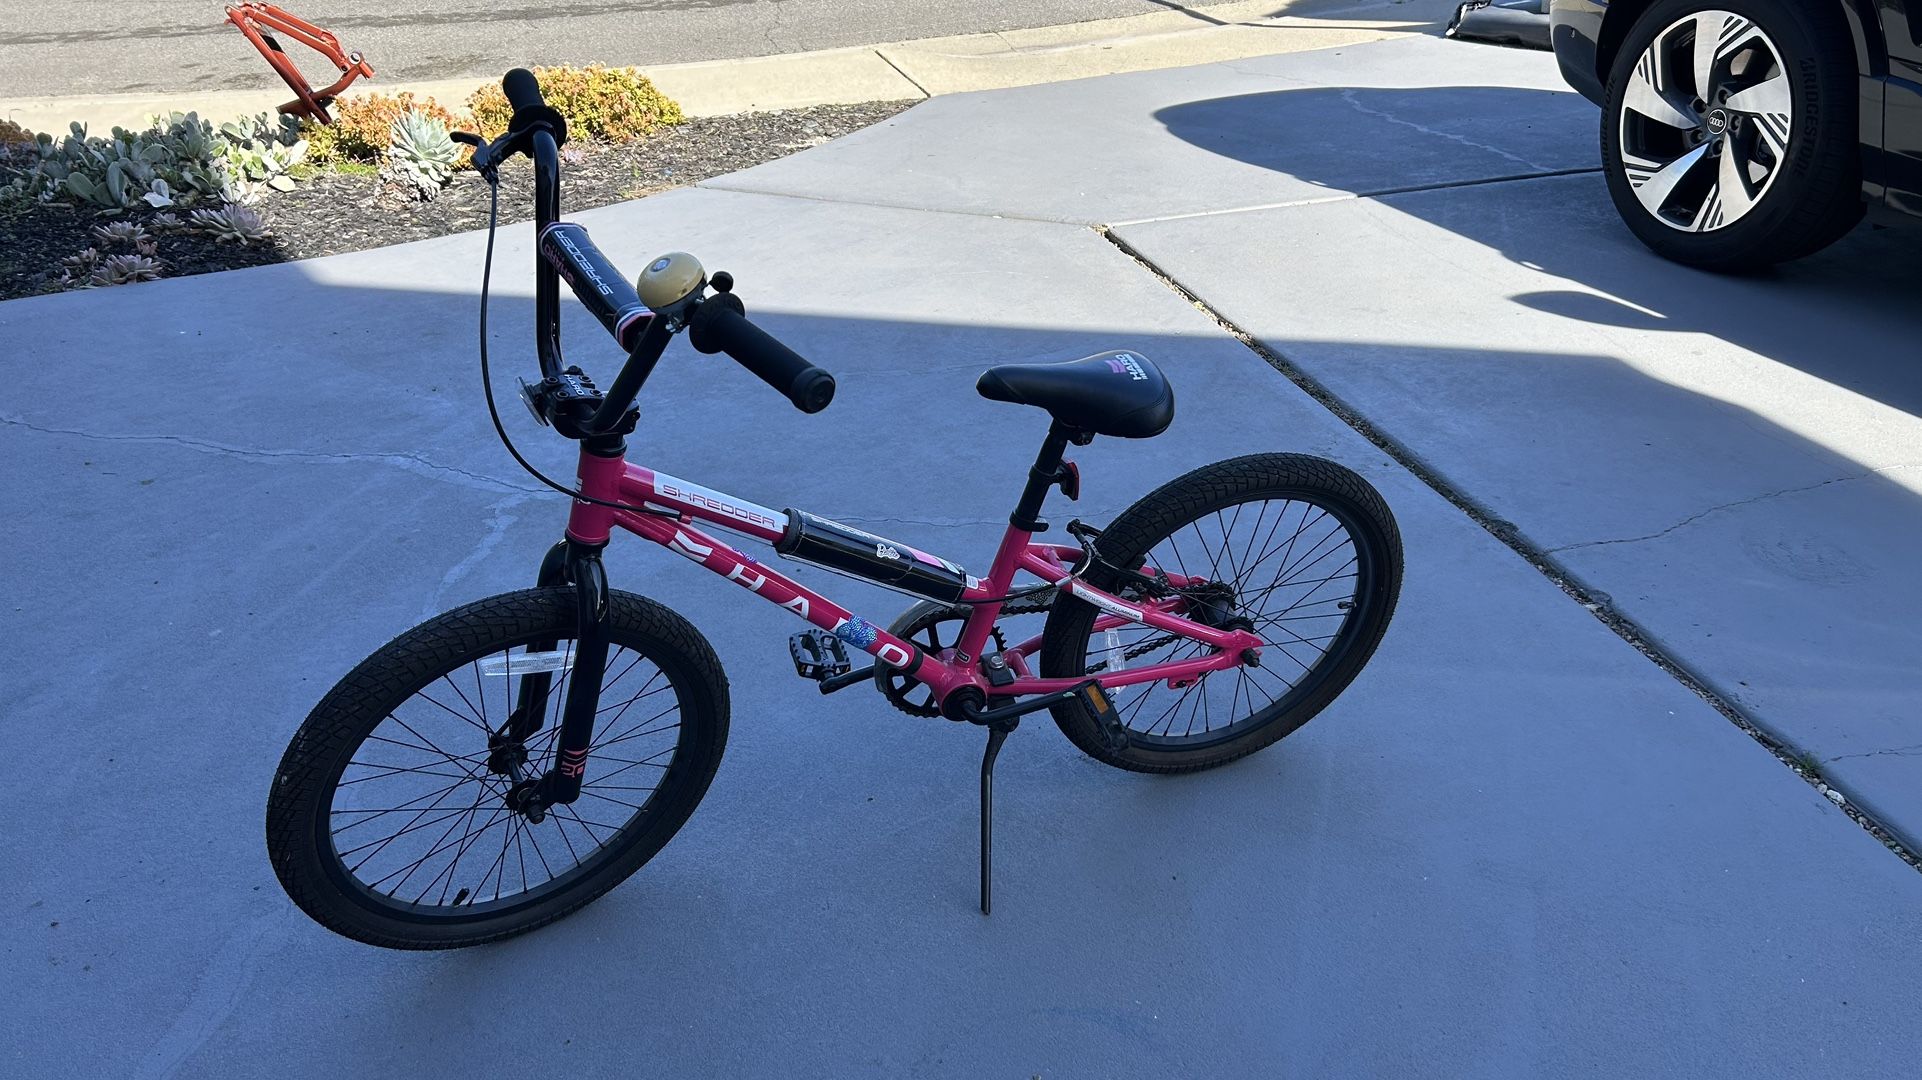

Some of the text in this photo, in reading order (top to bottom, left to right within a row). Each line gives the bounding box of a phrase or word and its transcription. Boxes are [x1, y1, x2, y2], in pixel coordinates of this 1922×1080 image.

[1793, 57, 1819, 177] BRIDGESTONE
[554, 229, 614, 296] SHREDDER
[564, 374, 585, 396] HARO
[1115, 354, 1142, 380] HARO
[663, 484, 776, 528] SHREDDER
[727, 563, 910, 668] HAO
